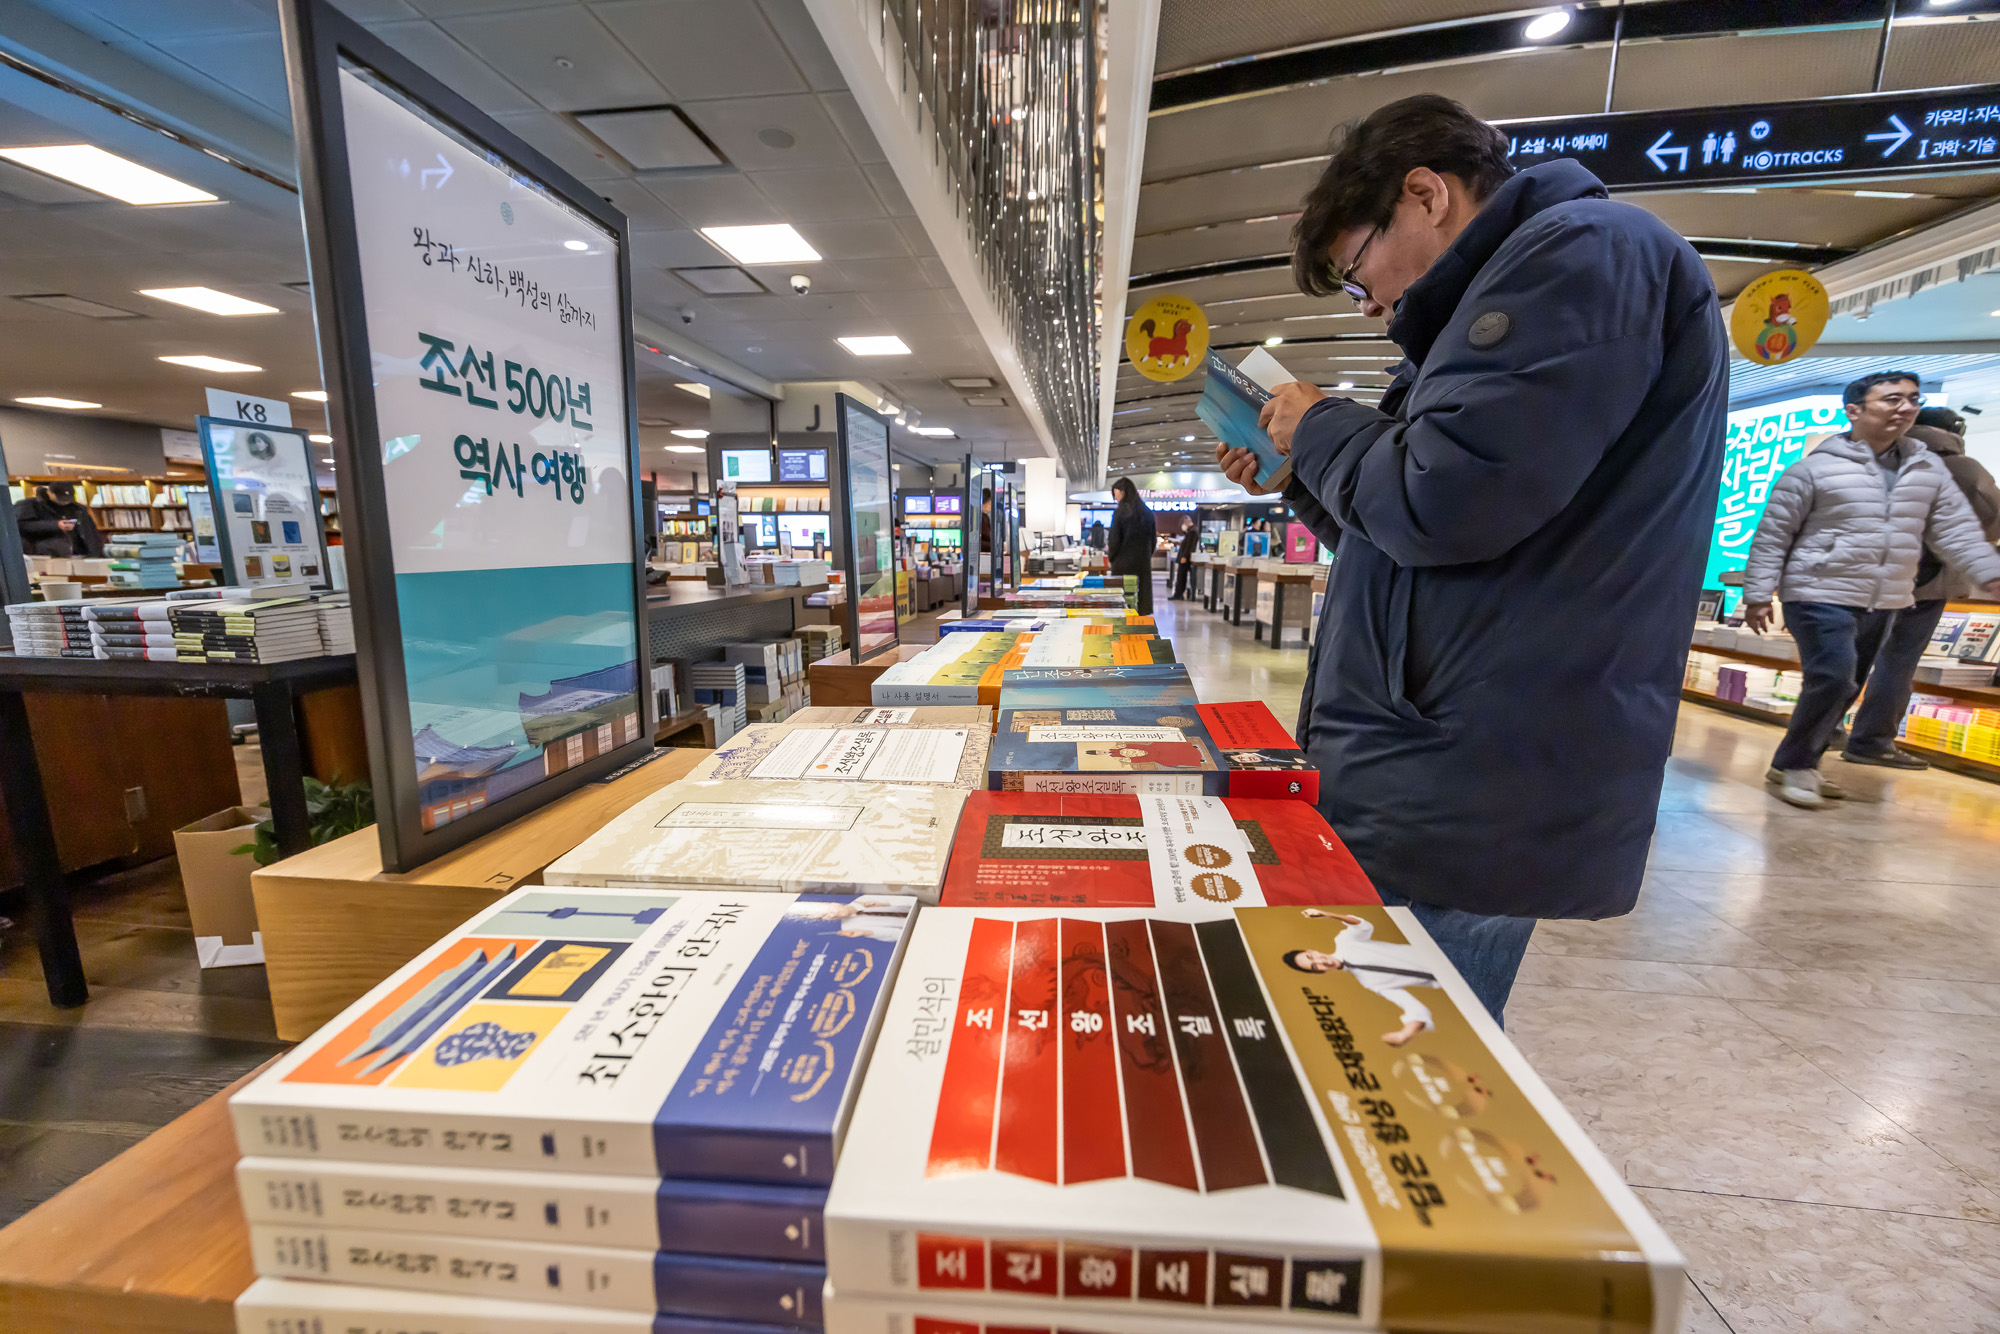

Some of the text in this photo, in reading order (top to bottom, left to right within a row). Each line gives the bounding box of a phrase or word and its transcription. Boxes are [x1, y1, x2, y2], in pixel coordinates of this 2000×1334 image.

[1506, 137, 1518, 157] J
[1917, 136, 1998, 159] I 과학·기술
[413, 227, 460, 273] 왕과
[557, 293, 596, 332] 삶까지
[418, 332, 594, 432] 조선 500년
[236, 400, 268, 423] K8
[805, 404, 820, 431] J
[1726, 412, 1806, 459] 직이는
[453, 433, 587, 505] 역사 여행
[948, 473, 957, 487] J
[1012, 666, 1134, 681] 단종애사
[881, 691, 939, 701] 나 사용 설명서
[1040, 731, 1168, 741] 조선왕조실록
[834, 731, 877, 774] 조선왕조실록
[1036, 779, 1127, 794] 조선왕조실록
[577, 966, 699, 1089] 최소한의
[677, 902, 750, 958] 한국사
[906, 977, 956, 1062] 설민석의
[1359, 1097, 1410, 1144] 항상
